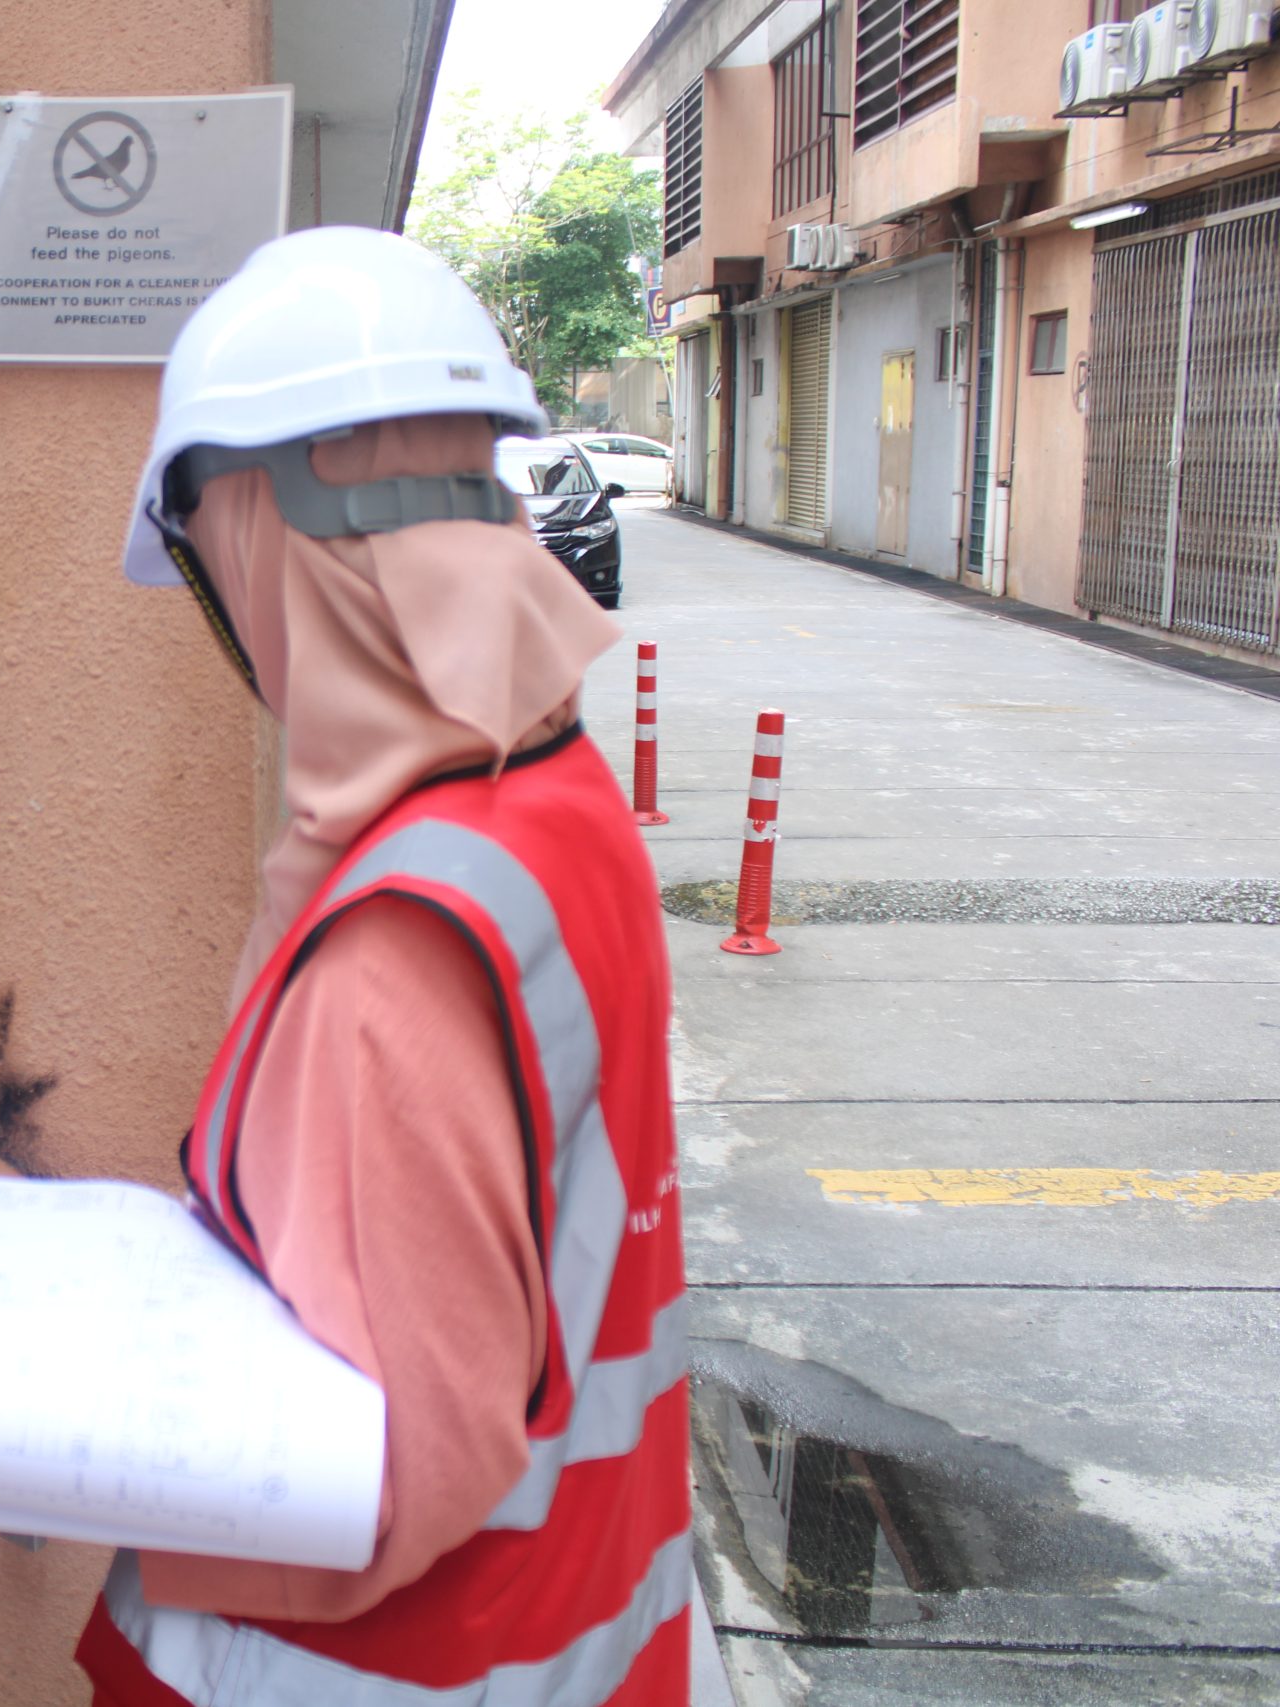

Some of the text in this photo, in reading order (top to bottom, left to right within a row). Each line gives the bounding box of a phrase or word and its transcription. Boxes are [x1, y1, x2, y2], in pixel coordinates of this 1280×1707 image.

[47, 226, 161, 240] Please do not
[31, 246, 176, 263] feed the pigeons.
[95, 278, 121, 289] FOR
[125, 278, 135, 289] A
[138, 278, 200, 289] CLEANER
[62, 296, 80, 307] TO
[83, 296, 125, 307] BUKIT
[129, 296, 183, 307] CHERAS
[186, 296, 199, 307] IS
[54, 314, 147, 325] APPRECIATED
